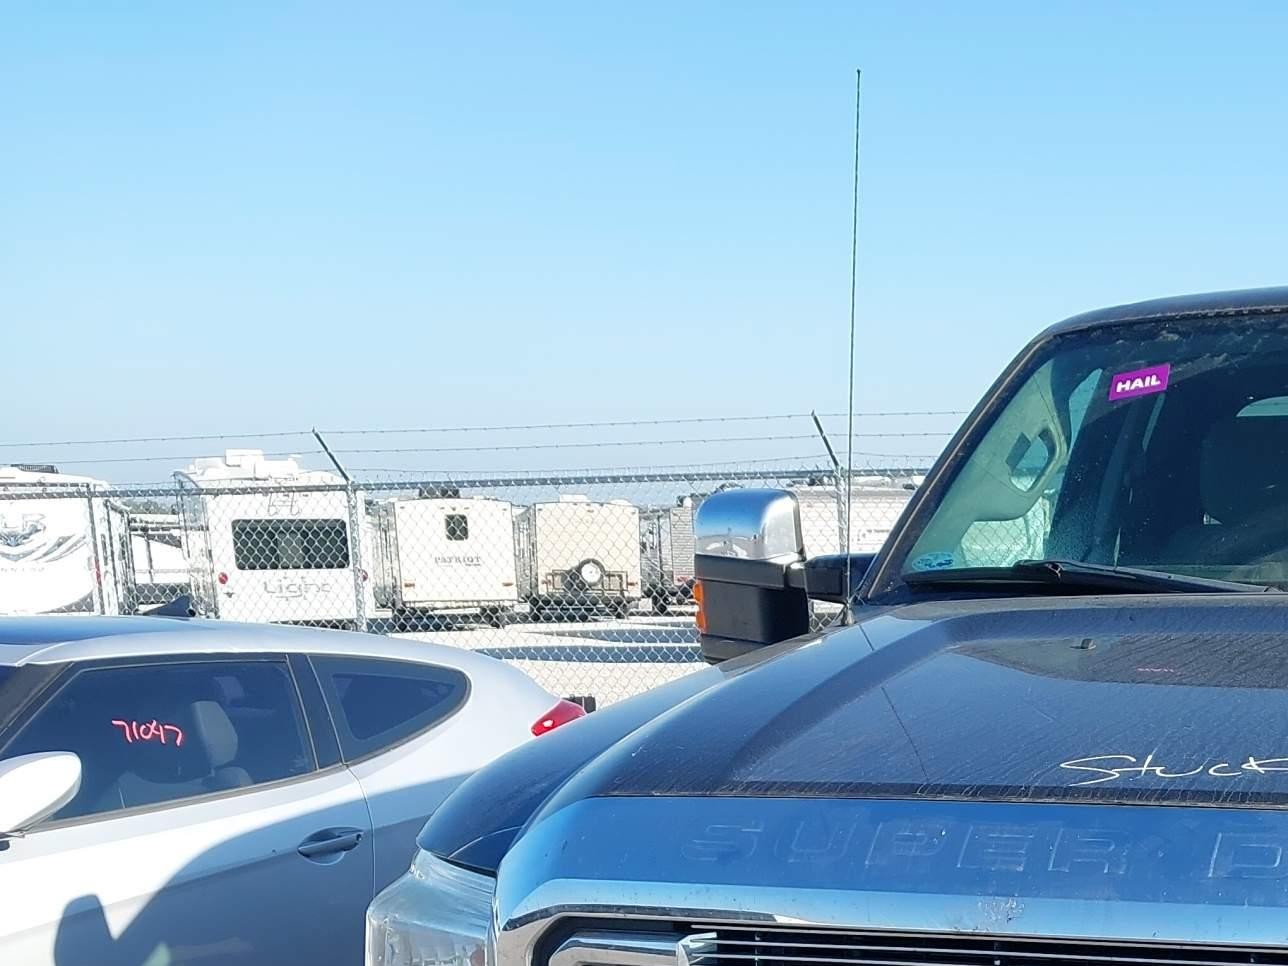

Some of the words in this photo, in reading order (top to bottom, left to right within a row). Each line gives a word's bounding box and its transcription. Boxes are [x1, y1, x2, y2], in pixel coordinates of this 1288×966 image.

[1116, 374, 1162, 393] HAIL
[111, 719, 183, 747] 71047
[680, 820, 1130, 877] SUPER
